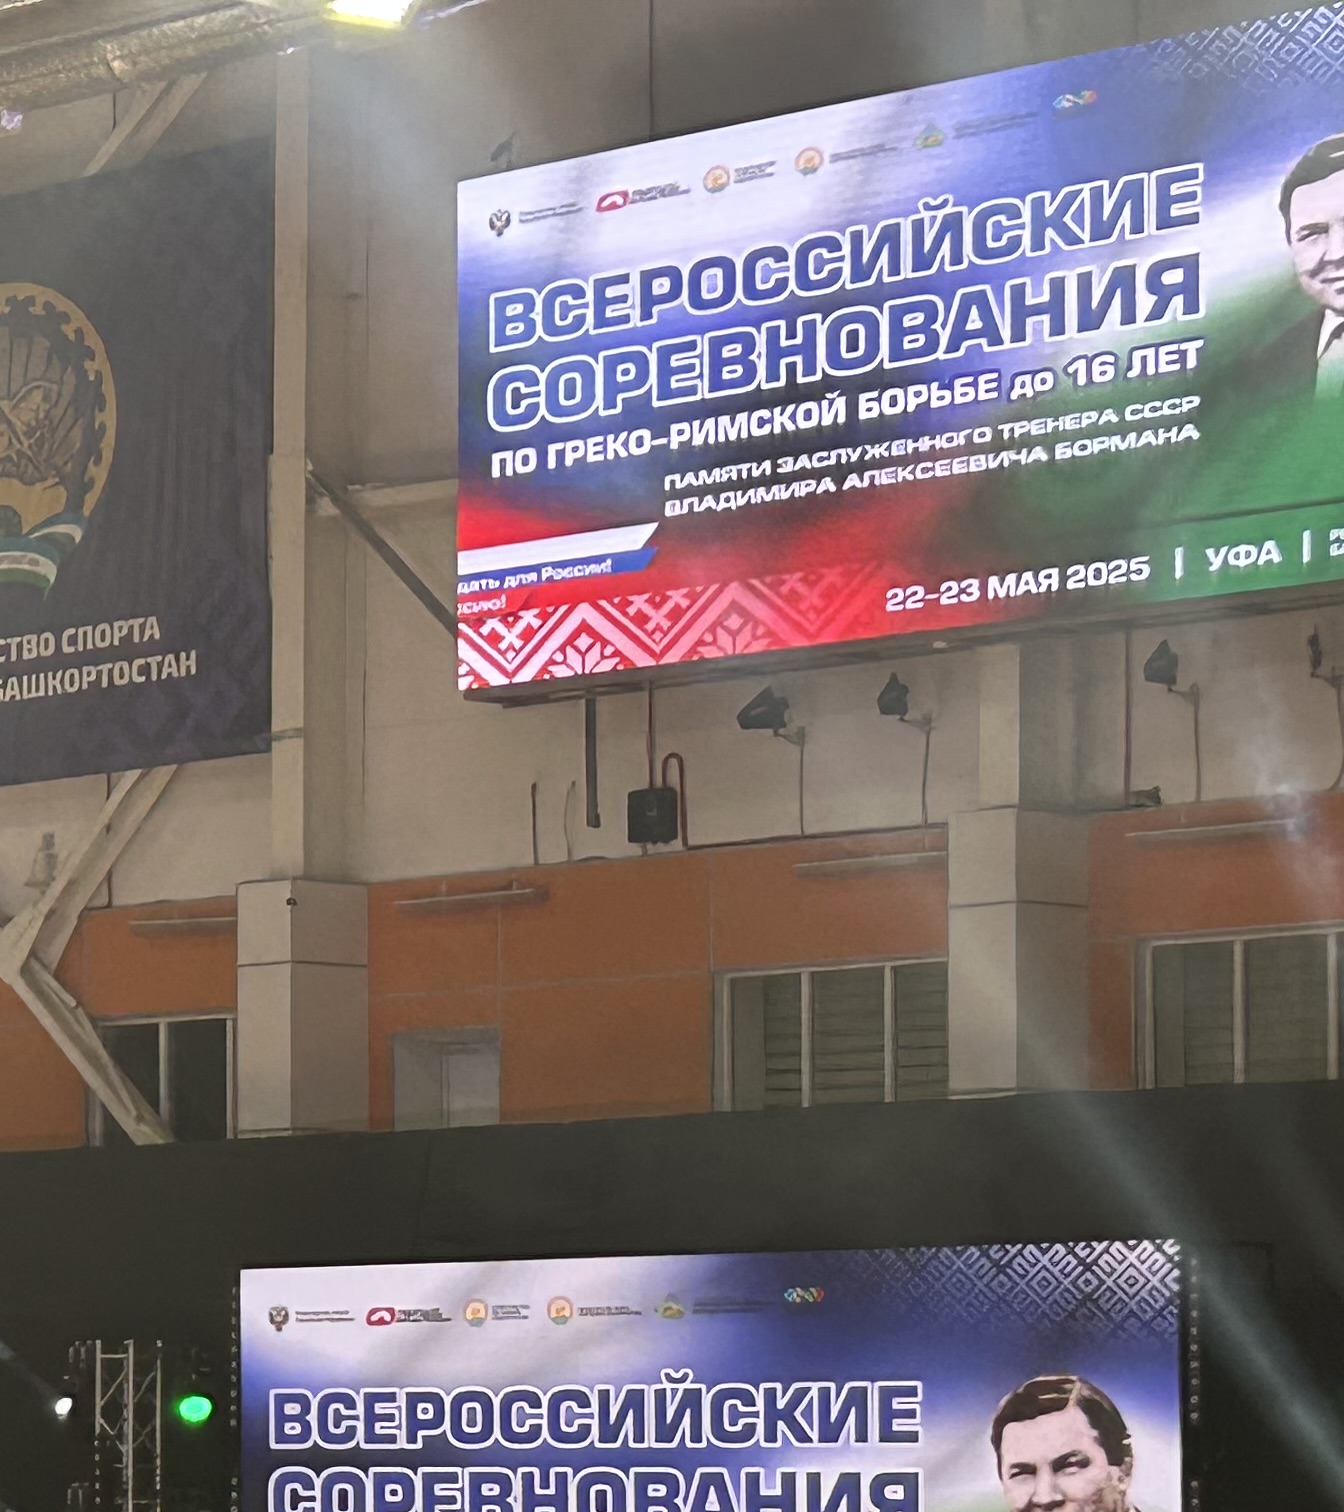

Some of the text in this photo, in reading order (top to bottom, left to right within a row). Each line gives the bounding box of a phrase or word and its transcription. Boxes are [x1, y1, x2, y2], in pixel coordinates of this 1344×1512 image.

[489, 161, 1204, 353] ВСЕРОССИЙСКИЕ
[487, 248, 1204, 433] СОРЕВНОВАНИЯ
[491, 338, 1205, 479] ПО ГРЕКО-РИМСКОЙ БОРЬБЕ до 16 ЛЕТ
[663, 394, 1202, 491] ПАМЯТИ ЗАСЛУЖЕННОГО ТРЕНЕРА СССР
[663, 423, 1201, 518] ВЛАДИМИРА АЛЕКСЕЕВИЧА БОРМАНА
[884, 555, 1151, 612] 22-23 МАЯ 2025
[1205, 538, 1282, 573] УФА
[61, 615, 161, 653] СПОРТА
[268, 1367, 923, 1450] ВСЕРОССИЙСКИЕ
